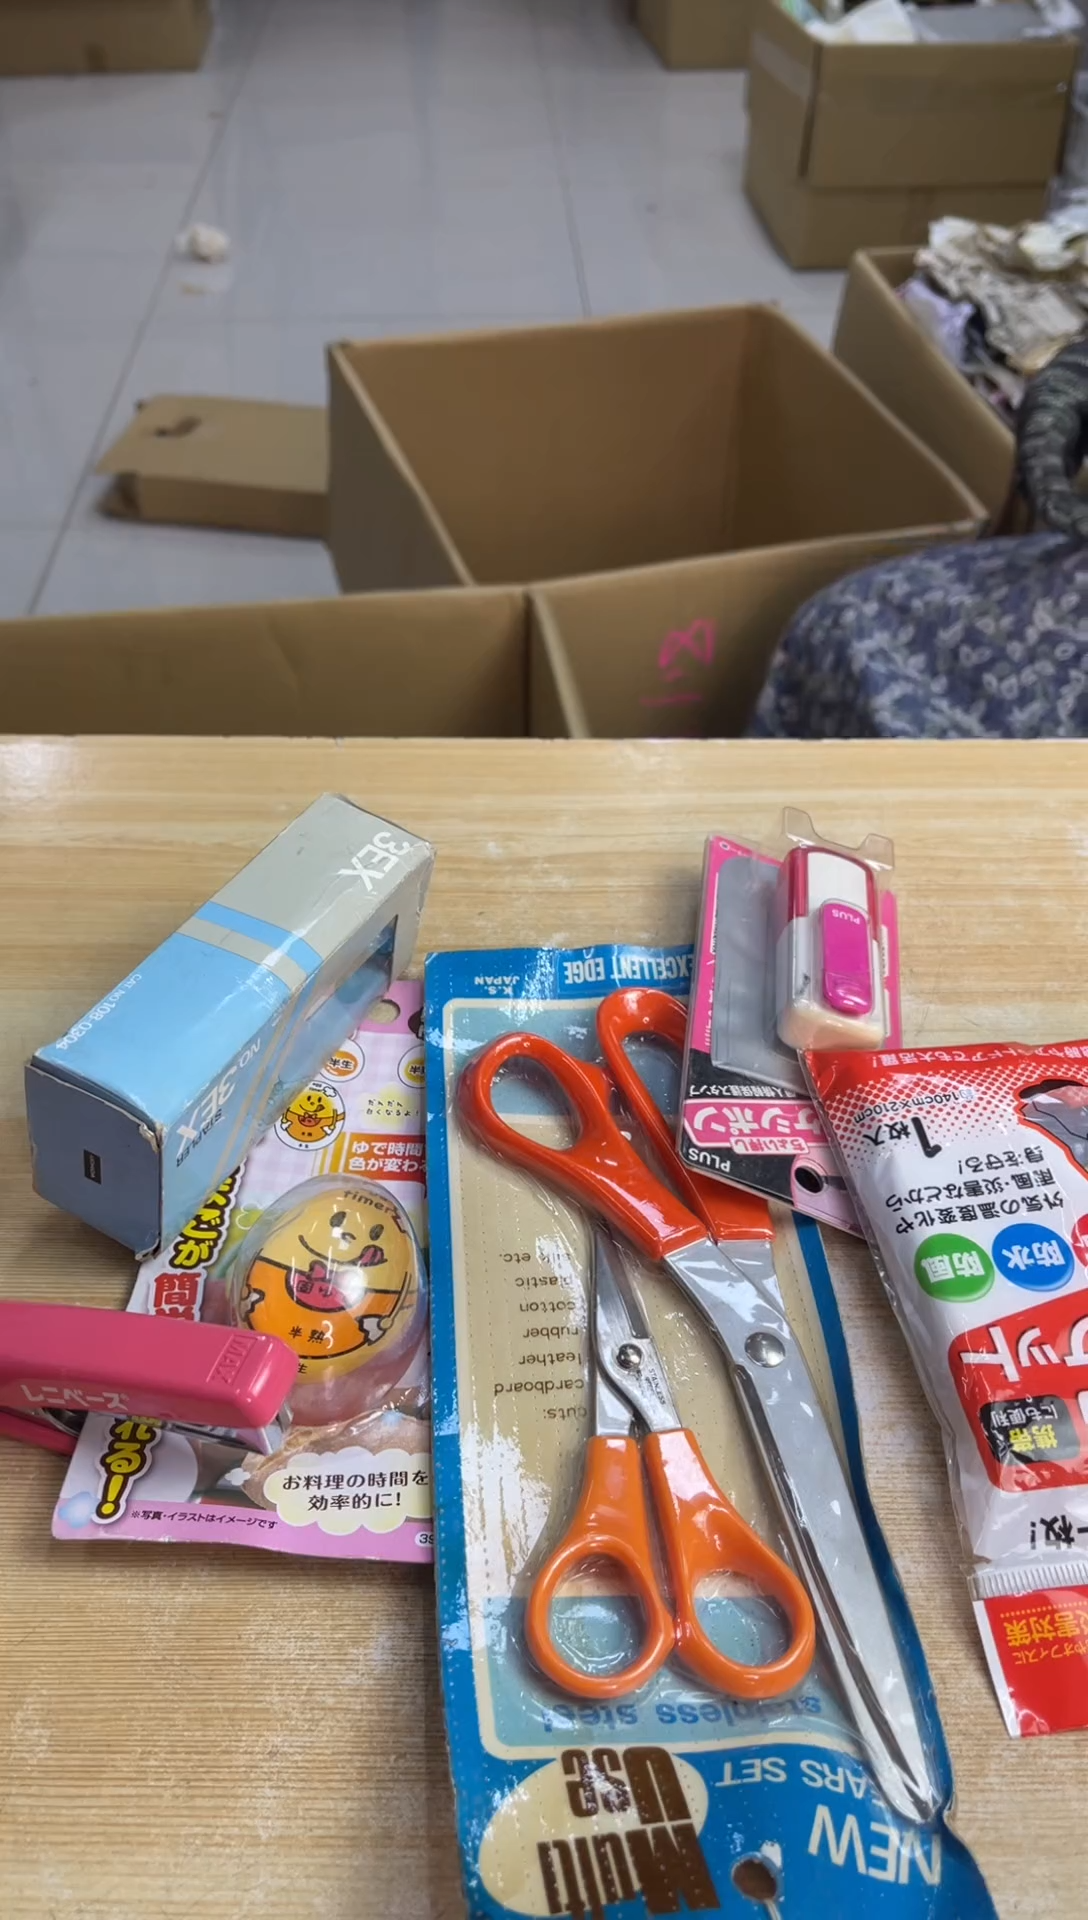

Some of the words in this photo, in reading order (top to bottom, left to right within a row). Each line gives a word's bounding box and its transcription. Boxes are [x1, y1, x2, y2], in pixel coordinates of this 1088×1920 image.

[337, 830, 414, 891] 3EX
[831, 907, 861, 926] PLUS
[474, 975, 520, 986] JAPAN
[564, 957, 606, 984] EDGE
[693, 1106, 821, 1136] ケシポン
[176, 1108, 222, 1168] STAPLER
[351, 1140, 426, 1157] ゆで時間
[734, 1138, 805, 1153] ちょい押し
[688, 1148, 732, 1173] PLUS
[343, 1189, 396, 1215] timer
[895, 1192, 1064, 1236] 外気の温度変化や
[500, 1252, 531, 1264] etc.
[920, 1250, 986, 1285] 防風
[1001, 1239, 1066, 1272] 防水
[296, 1280, 334, 1298] 固ゆ
[514, 1274, 573, 1289] plastic
[520, 1301, 576, 1313] cotton
[288, 1325, 325, 1345] 半熟
[522, 1326, 579, 1339] rubber
[518, 1352, 582, 1366] leather
[494, 1378, 585, 1396] cardboard
[543, 1406, 588, 1420] cuts:
[991, 1403, 1058, 1428] にも便利
[1008, 1424, 1058, 1451] 携帯
[282, 1469, 429, 1491] お料理の時間を
[307, 1492, 401, 1512] 効率的に！
[418, 1533, 434, 1545] 39
[1014, 1638, 1088, 1665] やオフィスに
[542, 1702, 637, 1733] steel
[656, 1696, 821, 1728] stainless
[715, 1756, 788, 1788] SET
[808, 1804, 942, 1886] NEW
[537, 1823, 720, 1920] Multi
